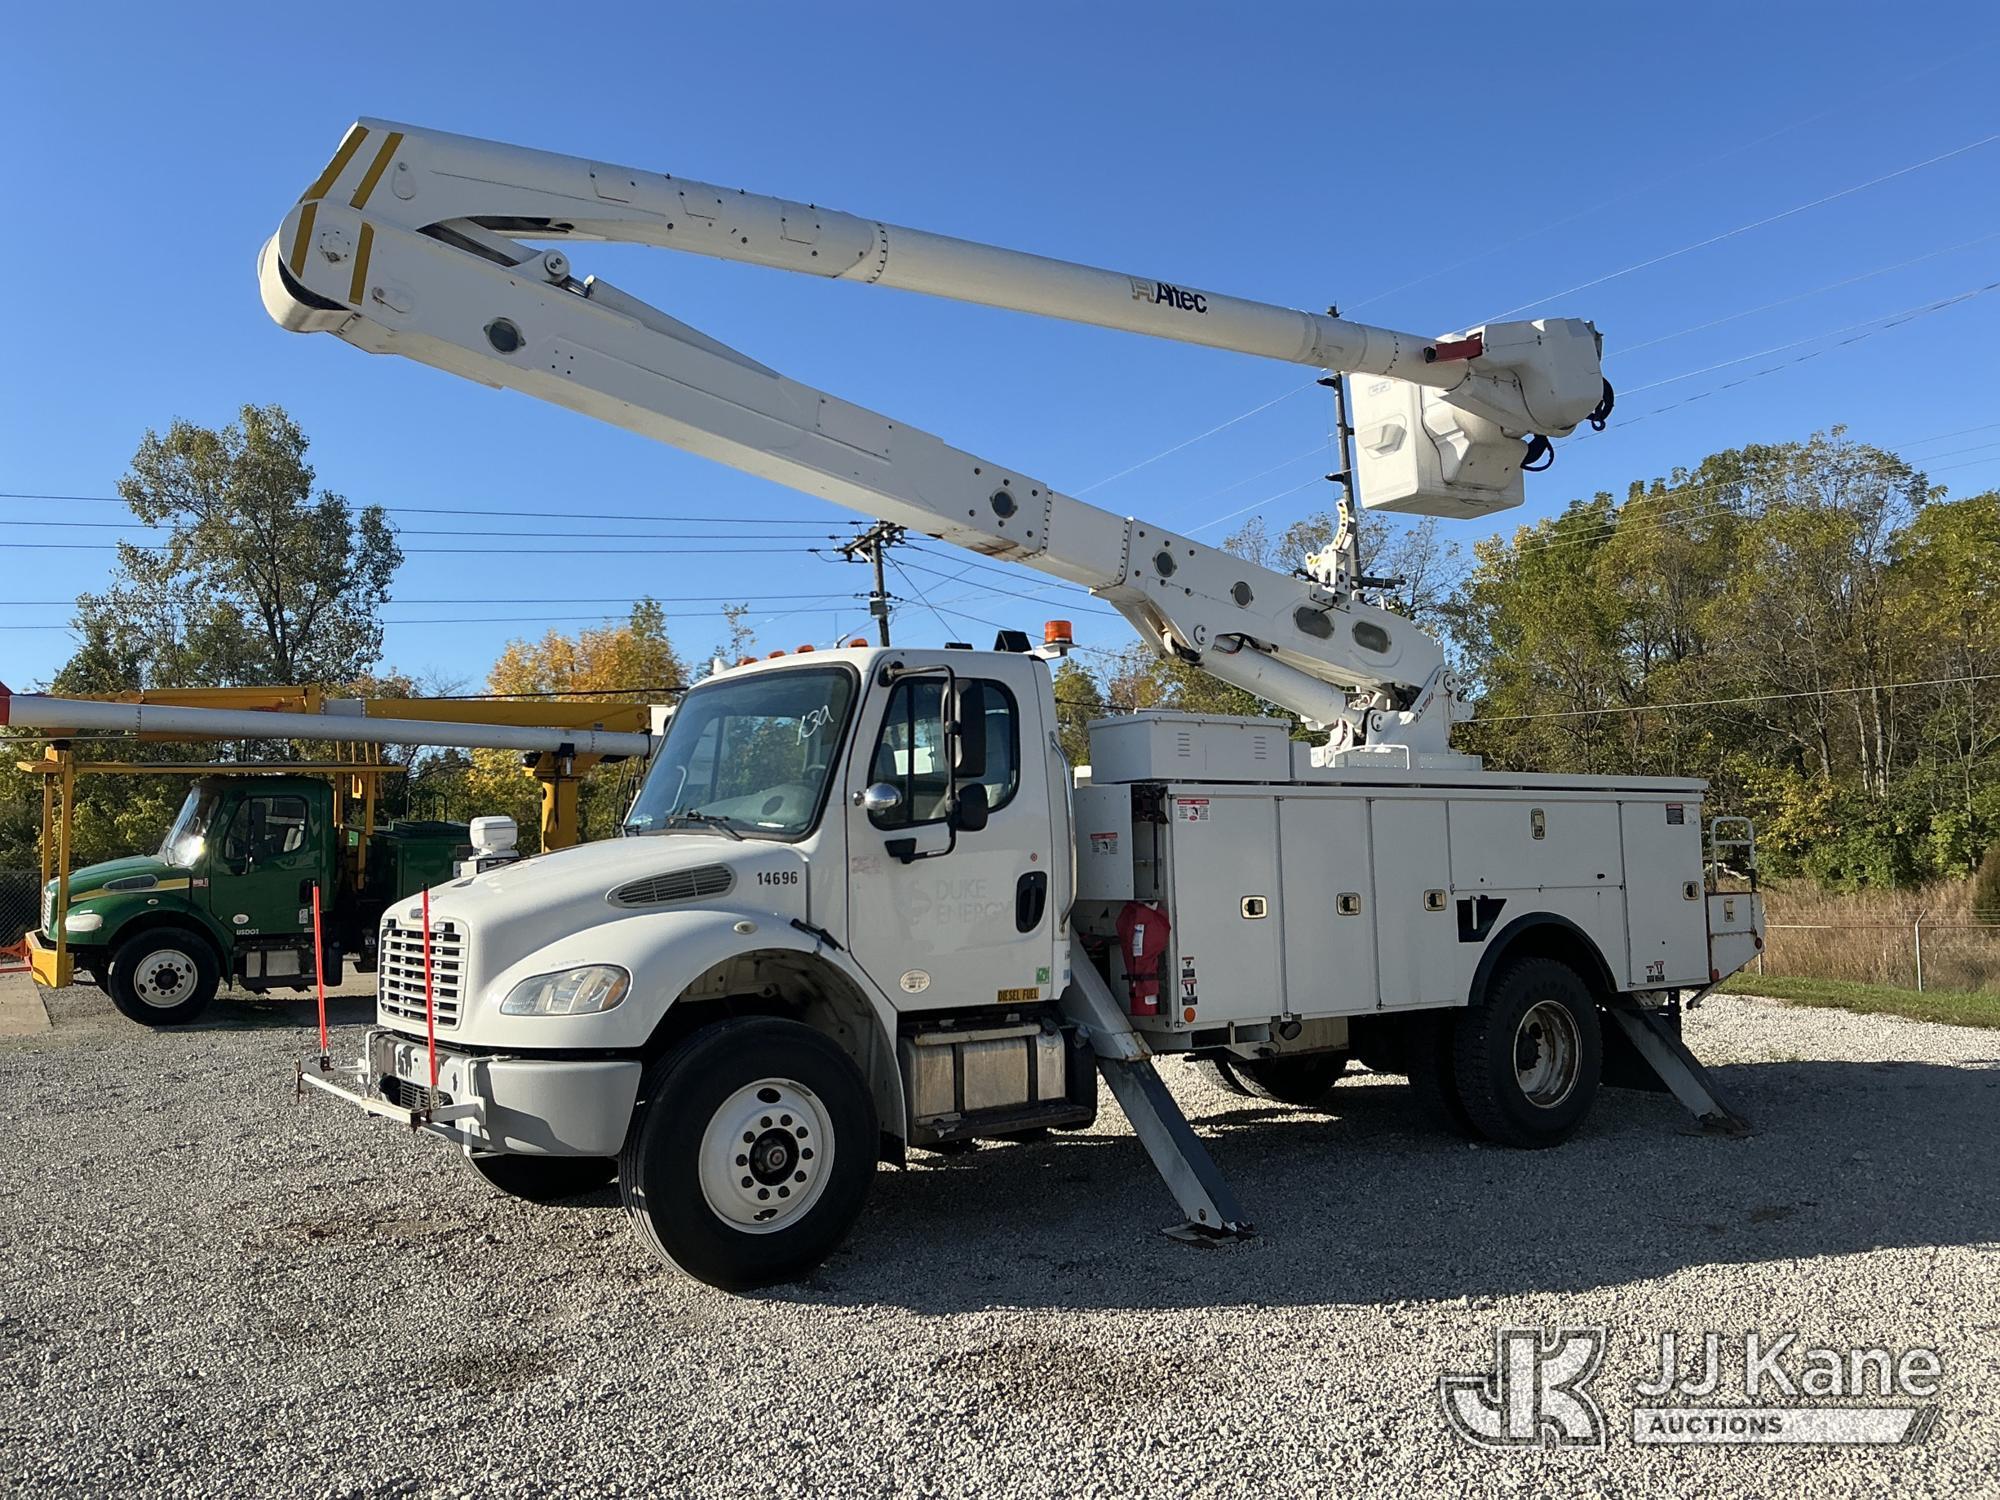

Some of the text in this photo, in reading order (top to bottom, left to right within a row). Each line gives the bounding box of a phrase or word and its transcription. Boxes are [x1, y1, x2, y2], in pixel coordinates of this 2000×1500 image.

[1155, 281, 1208, 314] Altec
[756, 871, 798, 886] 14696
[935, 879, 989, 900] DUKE
[935, 900, 1011, 925] ENERGY
[997, 987, 1040, 1002] DIESEL FUEL
